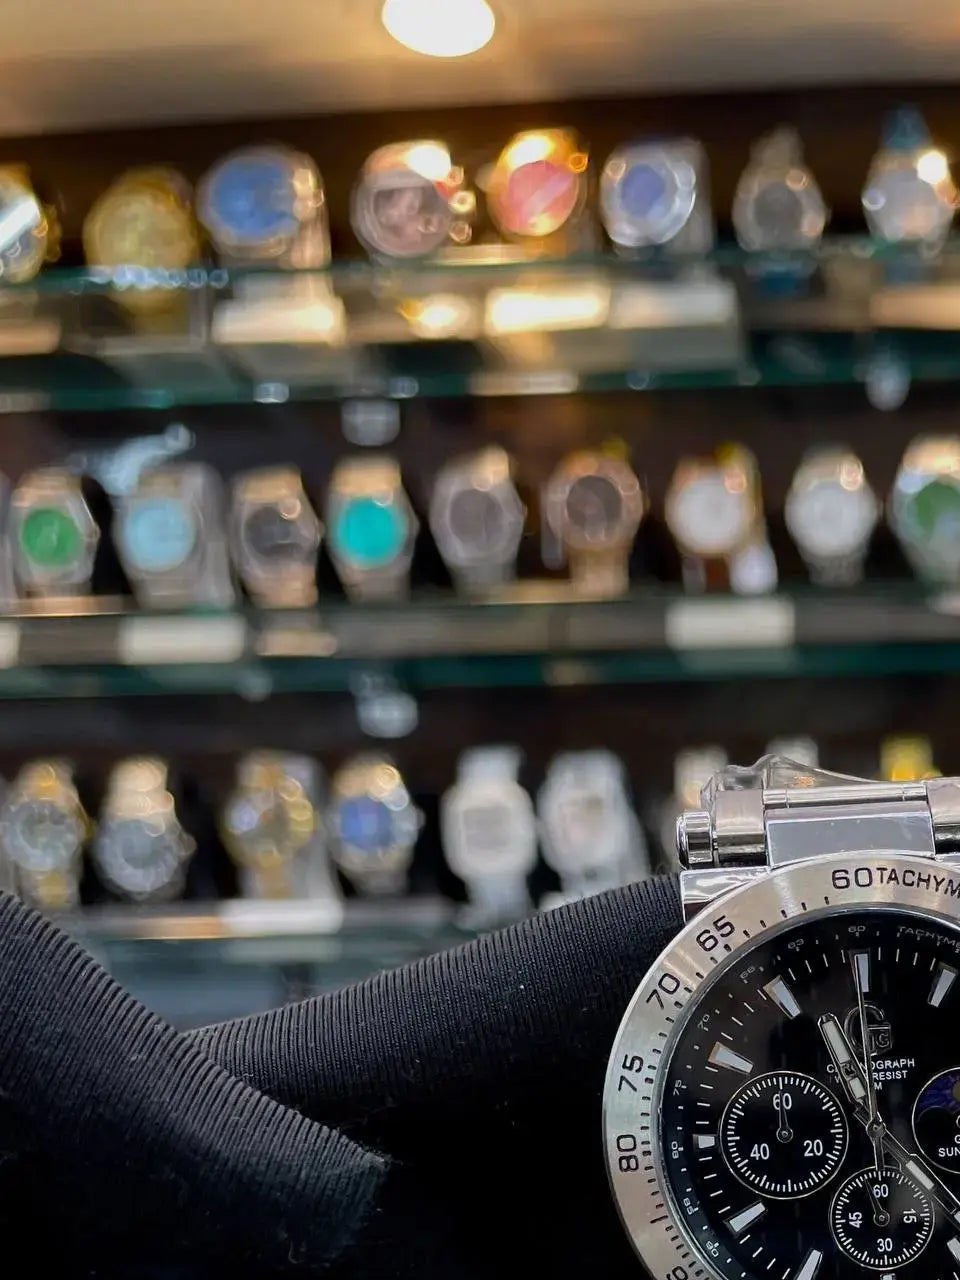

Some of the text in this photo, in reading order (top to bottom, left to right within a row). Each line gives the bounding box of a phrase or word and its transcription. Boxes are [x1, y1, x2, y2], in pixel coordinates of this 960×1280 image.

[832, 867, 873, 890] 60
[695, 915, 736, 953] 65
[646, 972, 681, 1011] 70
[617, 1053, 644, 1094] 75
[872, 1070, 908, 1081] RESIST
[772, 1092, 792, 1111] 60
[616, 1134, 639, 1173] 80
[670, 1141, 680, 1160] 80
[750, 1143, 770, 1161] 40
[803, 1139, 824, 1158] 20
[873, 1183, 890, 1199] 60
[682, 1197, 694, 1216] 85
[902, 1208, 918, 1224] 15
[848, 1210, 863, 1229] 45
[706, 1240, 720, 1258] 90
[876, 1238, 893, 1253] 30
